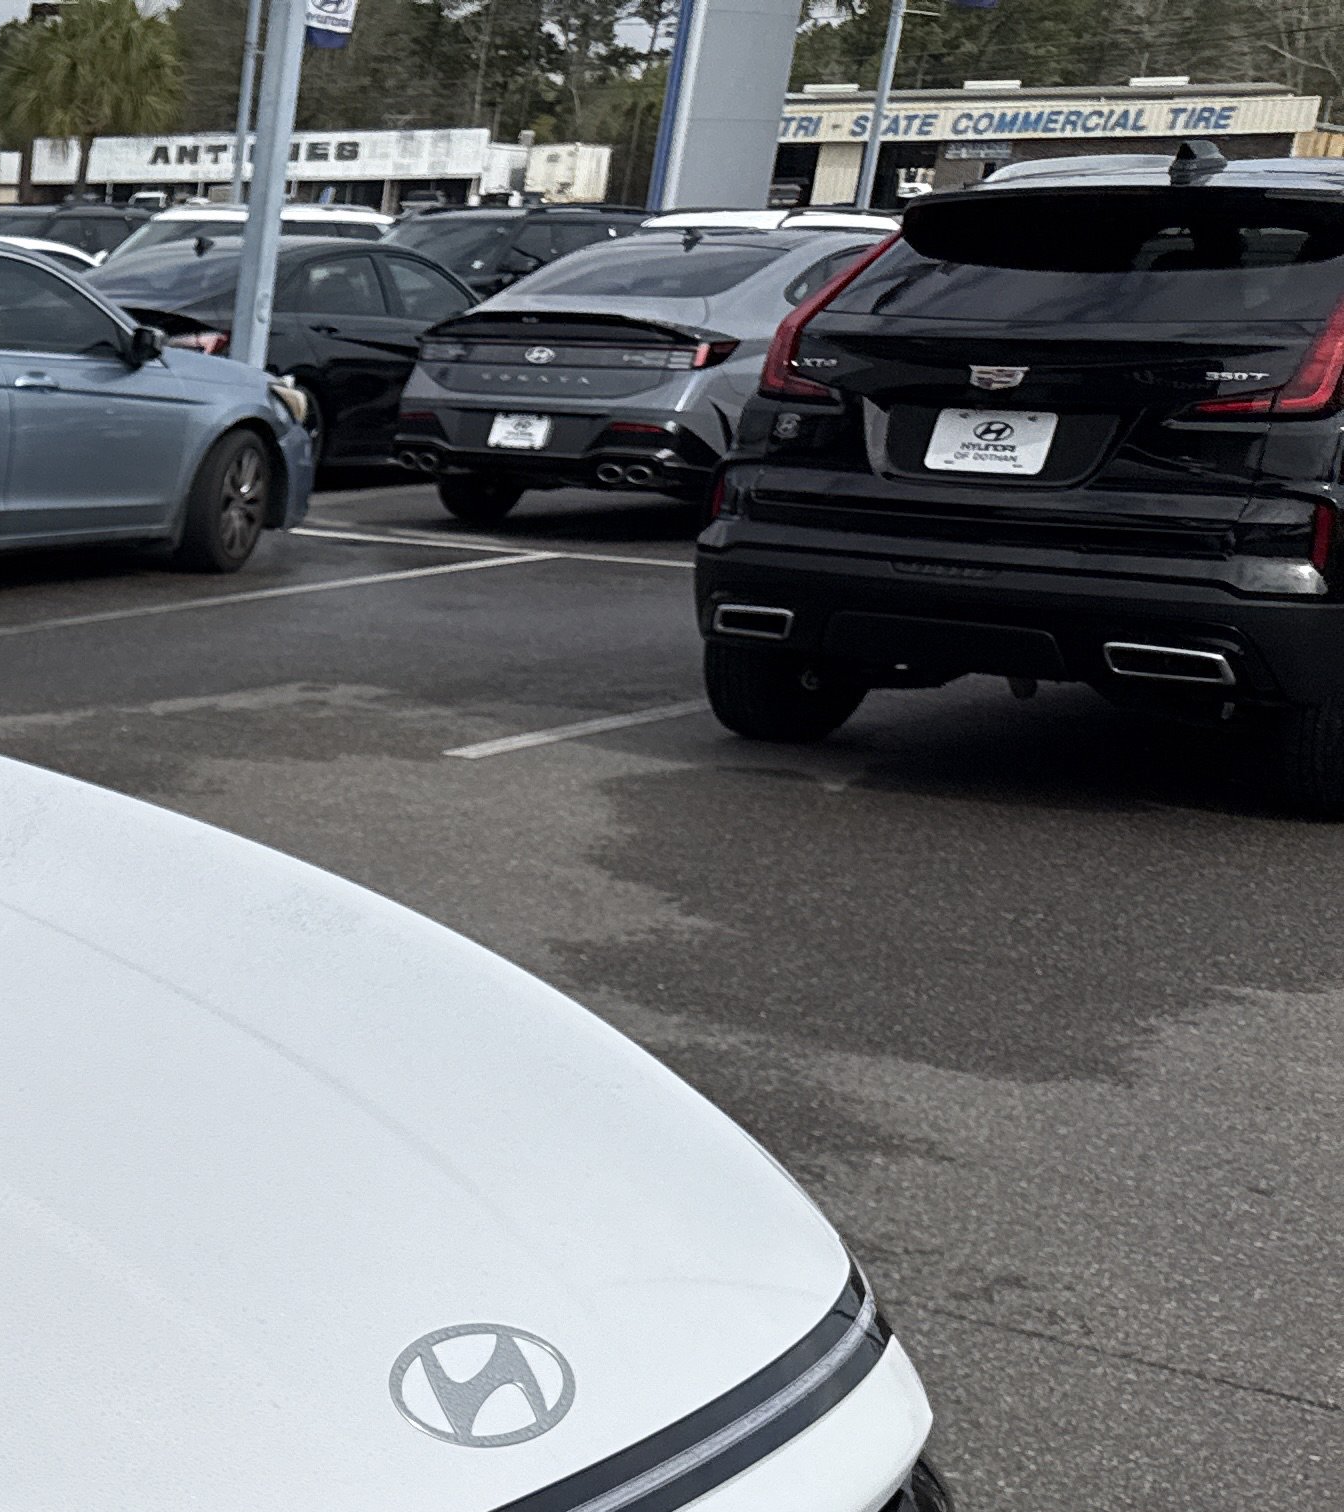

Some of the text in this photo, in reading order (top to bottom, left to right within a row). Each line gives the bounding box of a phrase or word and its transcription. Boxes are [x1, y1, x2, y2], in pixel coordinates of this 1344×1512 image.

[779, 115, 823, 138] TRI
[848, 113, 940, 138] SATE
[951, 108, 1148, 136] COMMERCIAL
[1168, 105, 1239, 131] TIRE
[148, 141, 361, 166] ANTES
[1205, 371, 1271, 381] 350T
